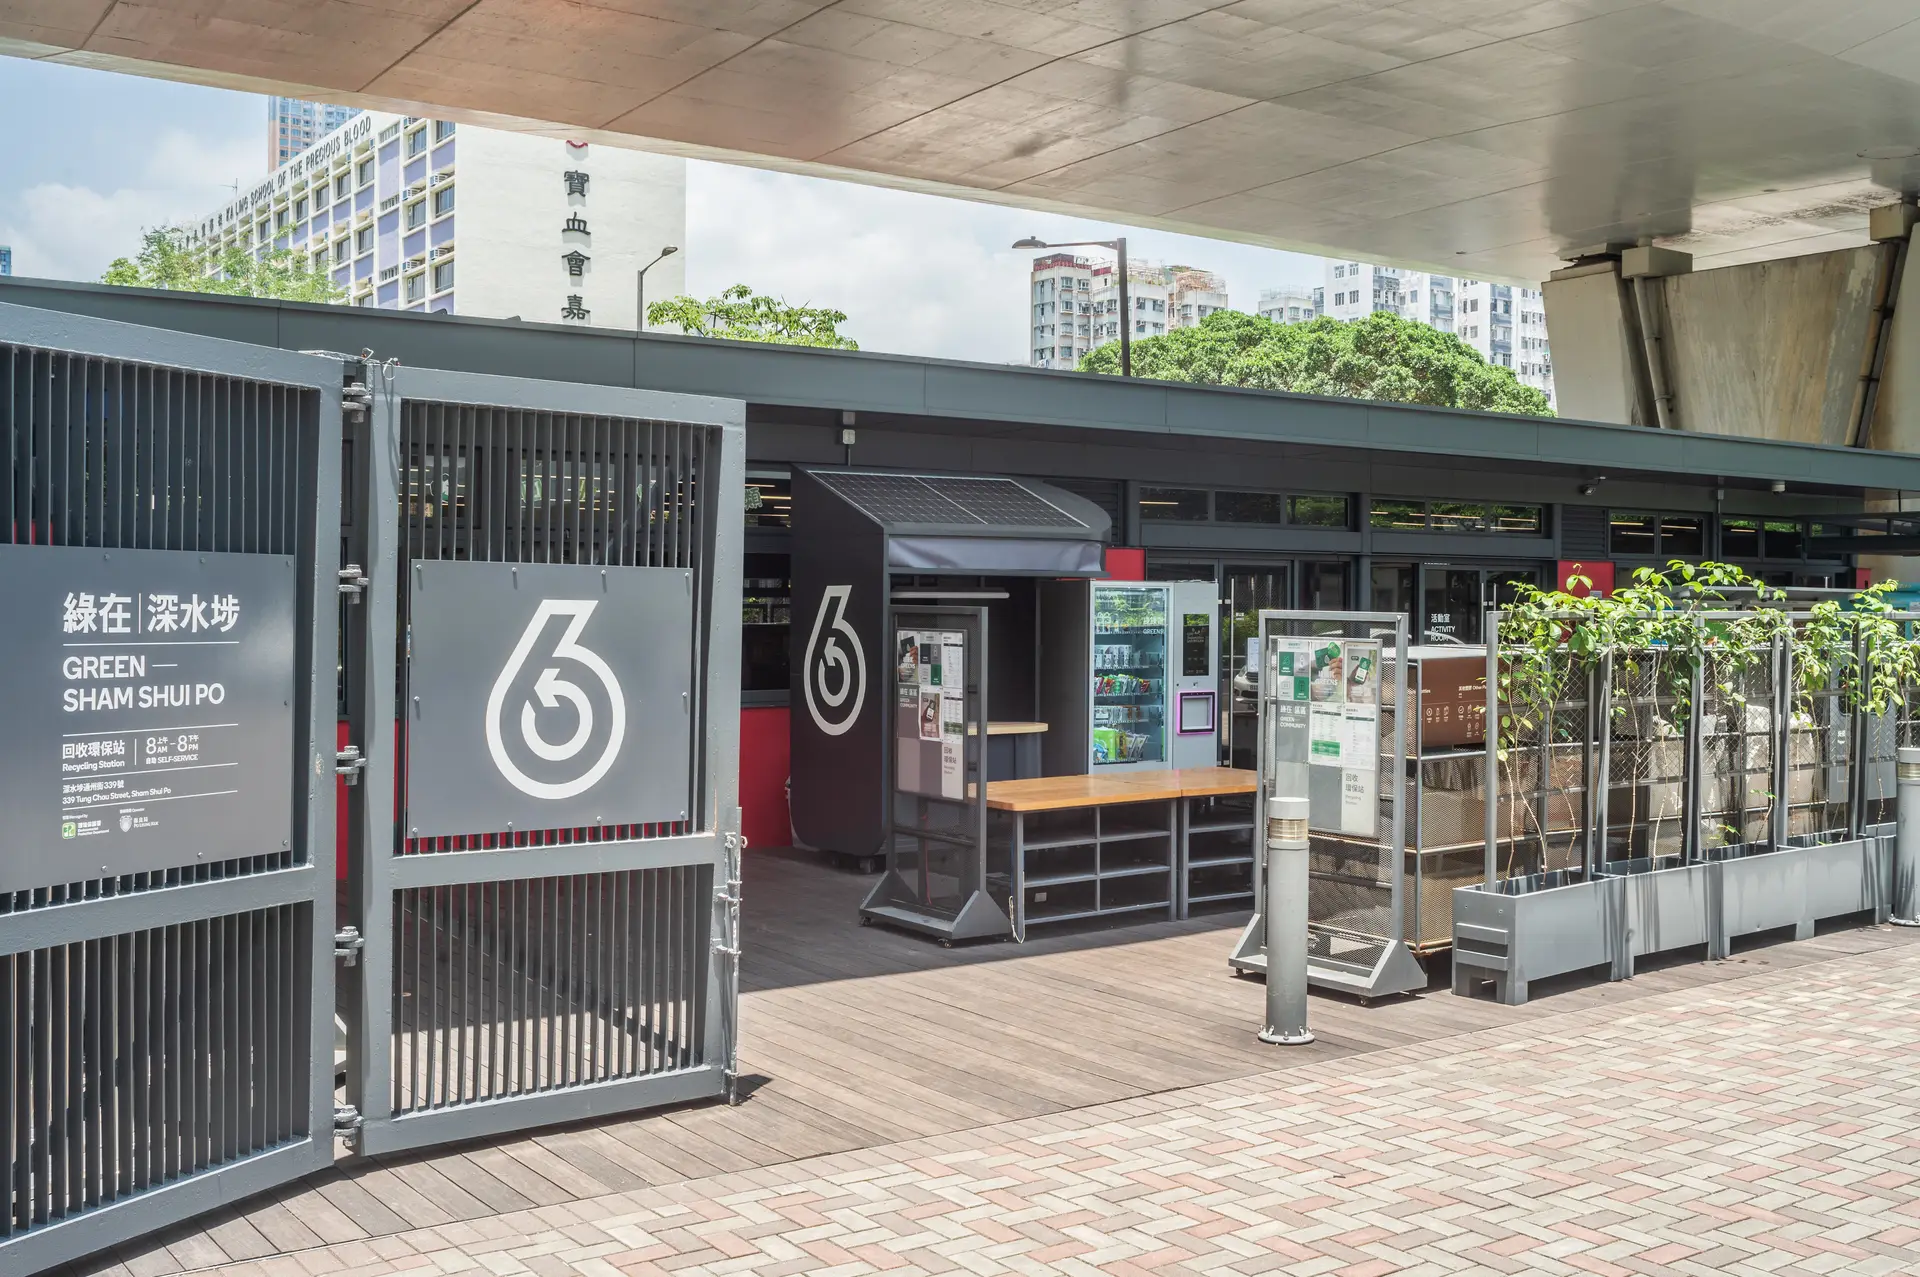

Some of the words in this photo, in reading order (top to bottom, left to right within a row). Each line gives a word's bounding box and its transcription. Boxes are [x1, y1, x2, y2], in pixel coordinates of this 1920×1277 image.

[250, 179, 275, 206] SCHOOL
[278, 171, 286, 188] OF
[290, 160, 303, 179] THE
[305, 136, 341, 171] PRECIOUS
[344, 116, 371, 147] BLOOD
[62, 592, 132, 634] 綠在
[147, 594, 240, 633] 深水埗
[1431, 613, 1450, 623] 活動室
[1430, 634, 1449, 642] ROOM
[1431, 625, 1456, 633] ACTIVITY
[62, 655, 146, 680] GREEN
[62, 686, 133, 712] SHAM
[138, 684, 190, 709] SHUI
[195, 682, 226, 706] PO
[62, 740, 125, 760] 回收環保站
[146, 737, 157, 755] 8
[177, 735, 188, 752] 8
[157, 746, 168, 754] AM
[188, 743, 199, 751] PM
[62, 762, 98, 772] Recycling
[98, 759, 125, 769] Station
[157, 753, 199, 764] SELF-SERVICE
[62, 795, 75, 805] 339
[76, 795, 92, 804] Tung
[92, 791, 110, 801] Chau
[110, 791, 131, 800] Street,
[131, 789, 149, 798] Sham
[149, 787, 164, 796] Shui
[163, 786, 172, 795] Po
